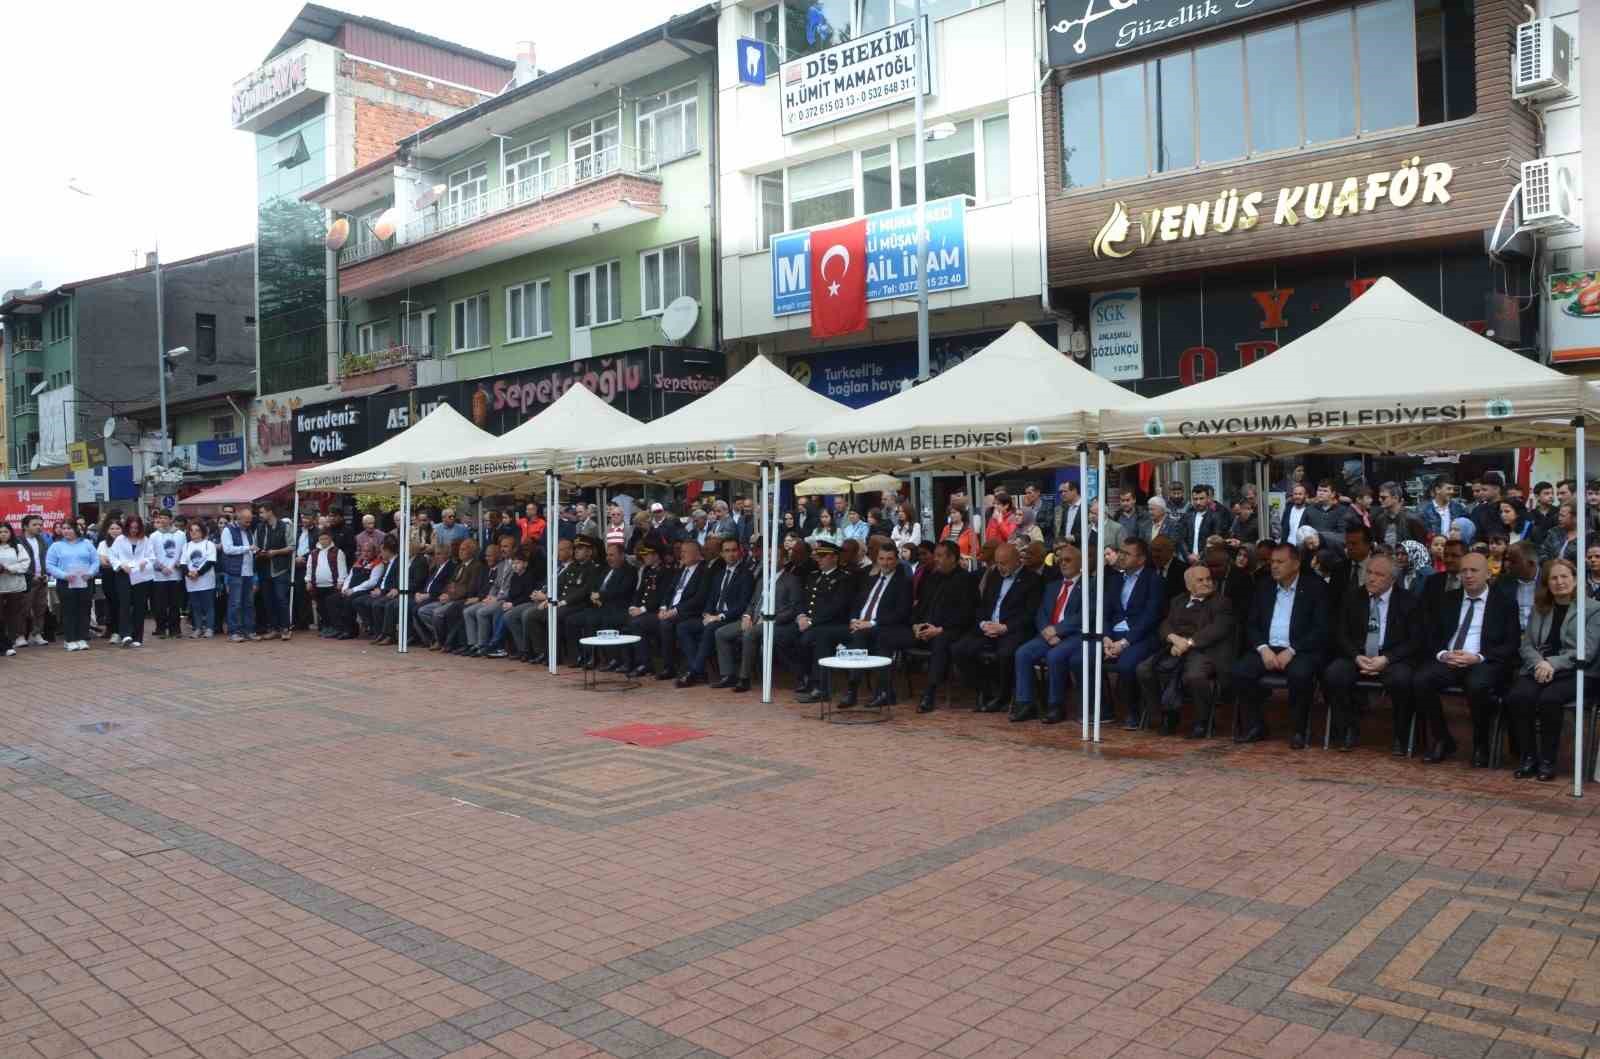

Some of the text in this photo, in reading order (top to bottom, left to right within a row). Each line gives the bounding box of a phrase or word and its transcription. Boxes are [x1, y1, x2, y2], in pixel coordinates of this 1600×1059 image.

[1115, 2, 1217, 47] Güzellik
[807, 53, 838, 79] DİŞ
[786, 80, 830, 108] H.ÜMİT
[1139, 155, 1453, 248] VENÜS KUAFÖR
[1097, 303, 1126, 323] SGK
[828, 375, 902, 397] bağlan haya
[297, 405, 356, 432] Karadeniz
[1307, 400, 1467, 429] BELEDİYESİ
[310, 428, 343, 457] Optik
[647, 446, 717, 464] BELEDİYESİ
[828, 427, 1013, 459] ÇAYCUMA BELEDİYESİ
